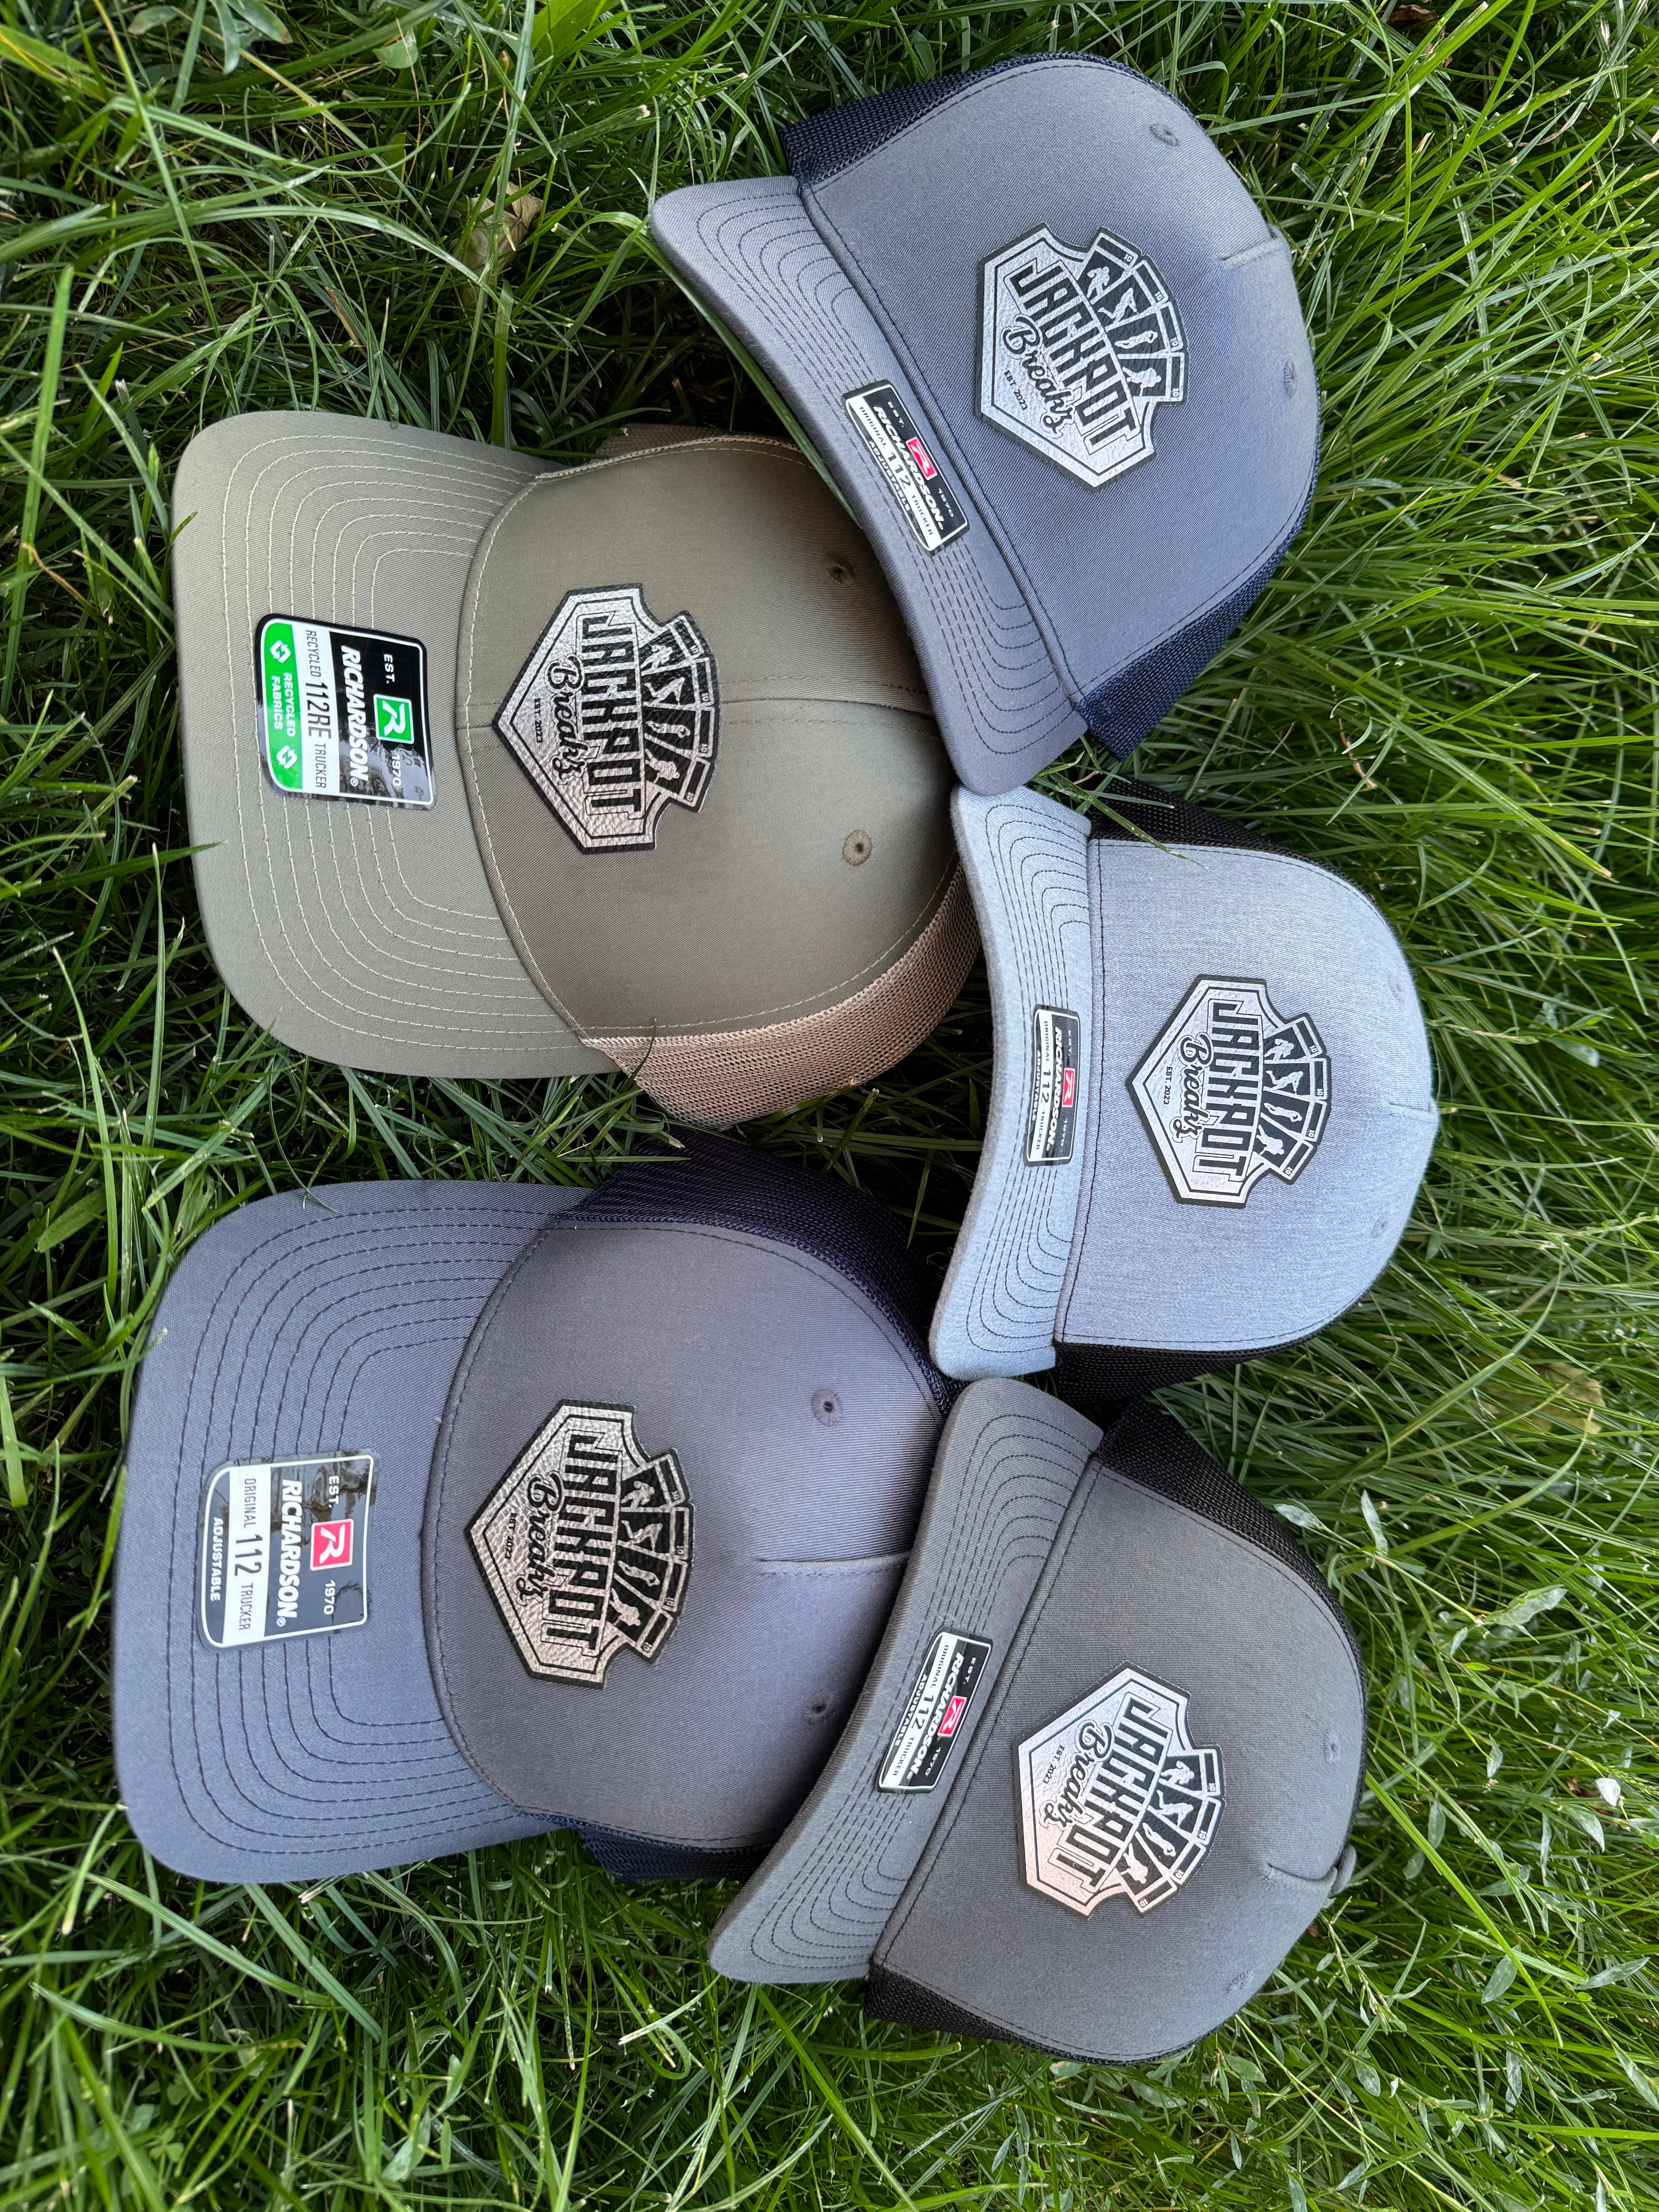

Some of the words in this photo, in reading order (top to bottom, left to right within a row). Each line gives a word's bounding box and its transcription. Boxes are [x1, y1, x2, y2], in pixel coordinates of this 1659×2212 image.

[1003, 316, 1073, 434] Breakz
[1009, 263, 1138, 445] JACKPOT
[1014, 390, 1028, 411] 2023
[860, 407, 886, 448] ORIGINAL
[888, 452, 912, 490] 112
[911, 494, 933, 535] TRUCKER
[868, 441, 910, 511] ADJUSTABLE
[306, 630, 321, 678] RECYCLED
[383, 653, 395, 684] EST.
[271, 676, 283, 730] FABRICS
[283, 672, 296, 737] RECYCLED
[305, 682, 331, 739] 112RE
[382, 700, 406, 736] R
[547, 655, 590, 778] Breakz
[582, 615, 641, 813] JACKPOT
[314, 743, 326, 788] TRUCKER
[391, 756, 402, 787] 1970
[1032, 1050, 1041, 1121] ADJUSTABLE
[1041, 1069, 1051, 1104] 112
[1176, 1033, 1212, 1140] Breakz
[1198, 1003, 1260, 1179] JACKPOT
[1036, 1110, 1046, 1150] TRUCKER
[244, 1478, 257, 1528] ORIGINAL
[328, 1475, 339, 1508] EST.
[210, 1516, 224, 1602] ADJUSTABLE
[234, 1534, 263, 1577] 112
[319, 1524, 345, 1564] R
[516, 1473, 562, 1602] Breakz
[546, 1434, 618, 1650] JACKPOT
[239, 1582, 253, 1631] TRUCKER
[323, 1579, 336, 1615] 1970
[930, 1645, 948, 1688] ORIGINAL
[895, 1674, 927, 1746] ADJUSTABLE
[912, 1695, 935, 1729] 112
[893, 1736, 914, 1776] TRUCKER
[1044, 1723, 1113, 1828] Breakz
[1054, 1698, 1169, 1889] JACKPOT
